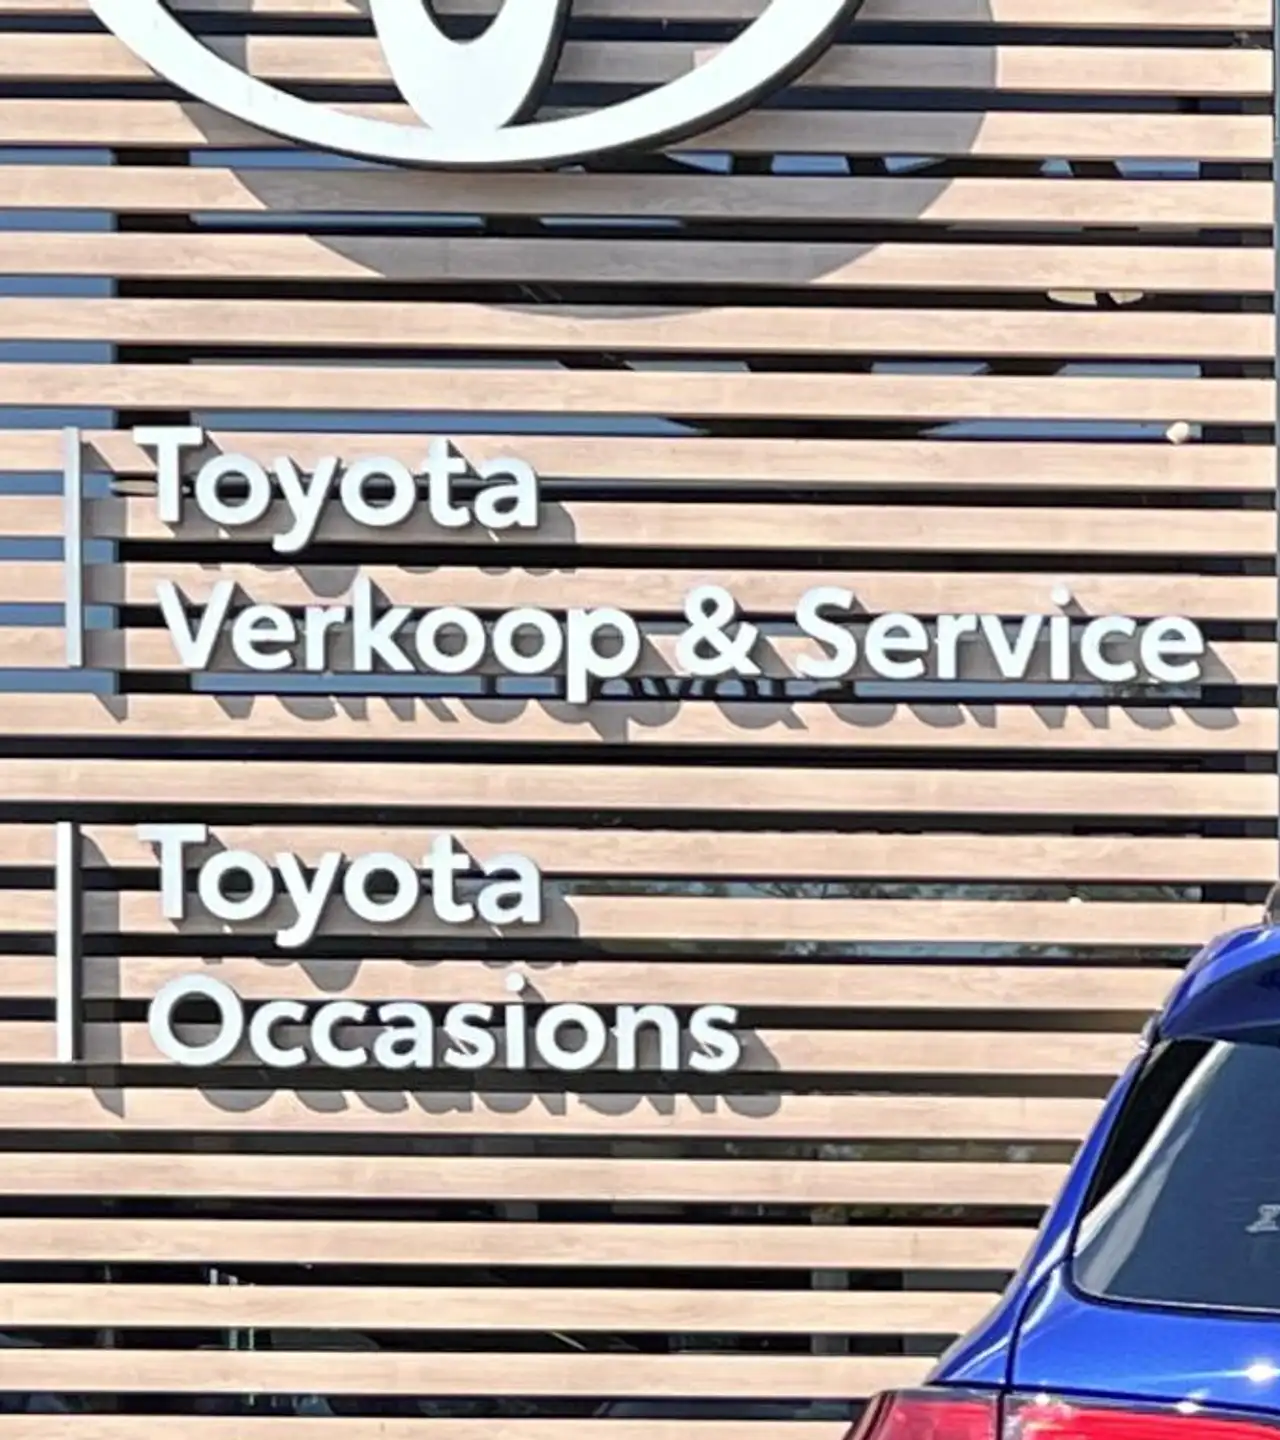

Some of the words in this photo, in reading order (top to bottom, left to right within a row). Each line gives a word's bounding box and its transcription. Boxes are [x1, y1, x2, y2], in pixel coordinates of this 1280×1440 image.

[135, 426, 540, 554] Toyota
[157, 577, 641, 703] Verkoop
[676, 585, 760, 676] &
[798, 586, 1205, 684] Service
[138, 825, 544, 947] Toyota
[149, 974, 744, 1073] Occasions
